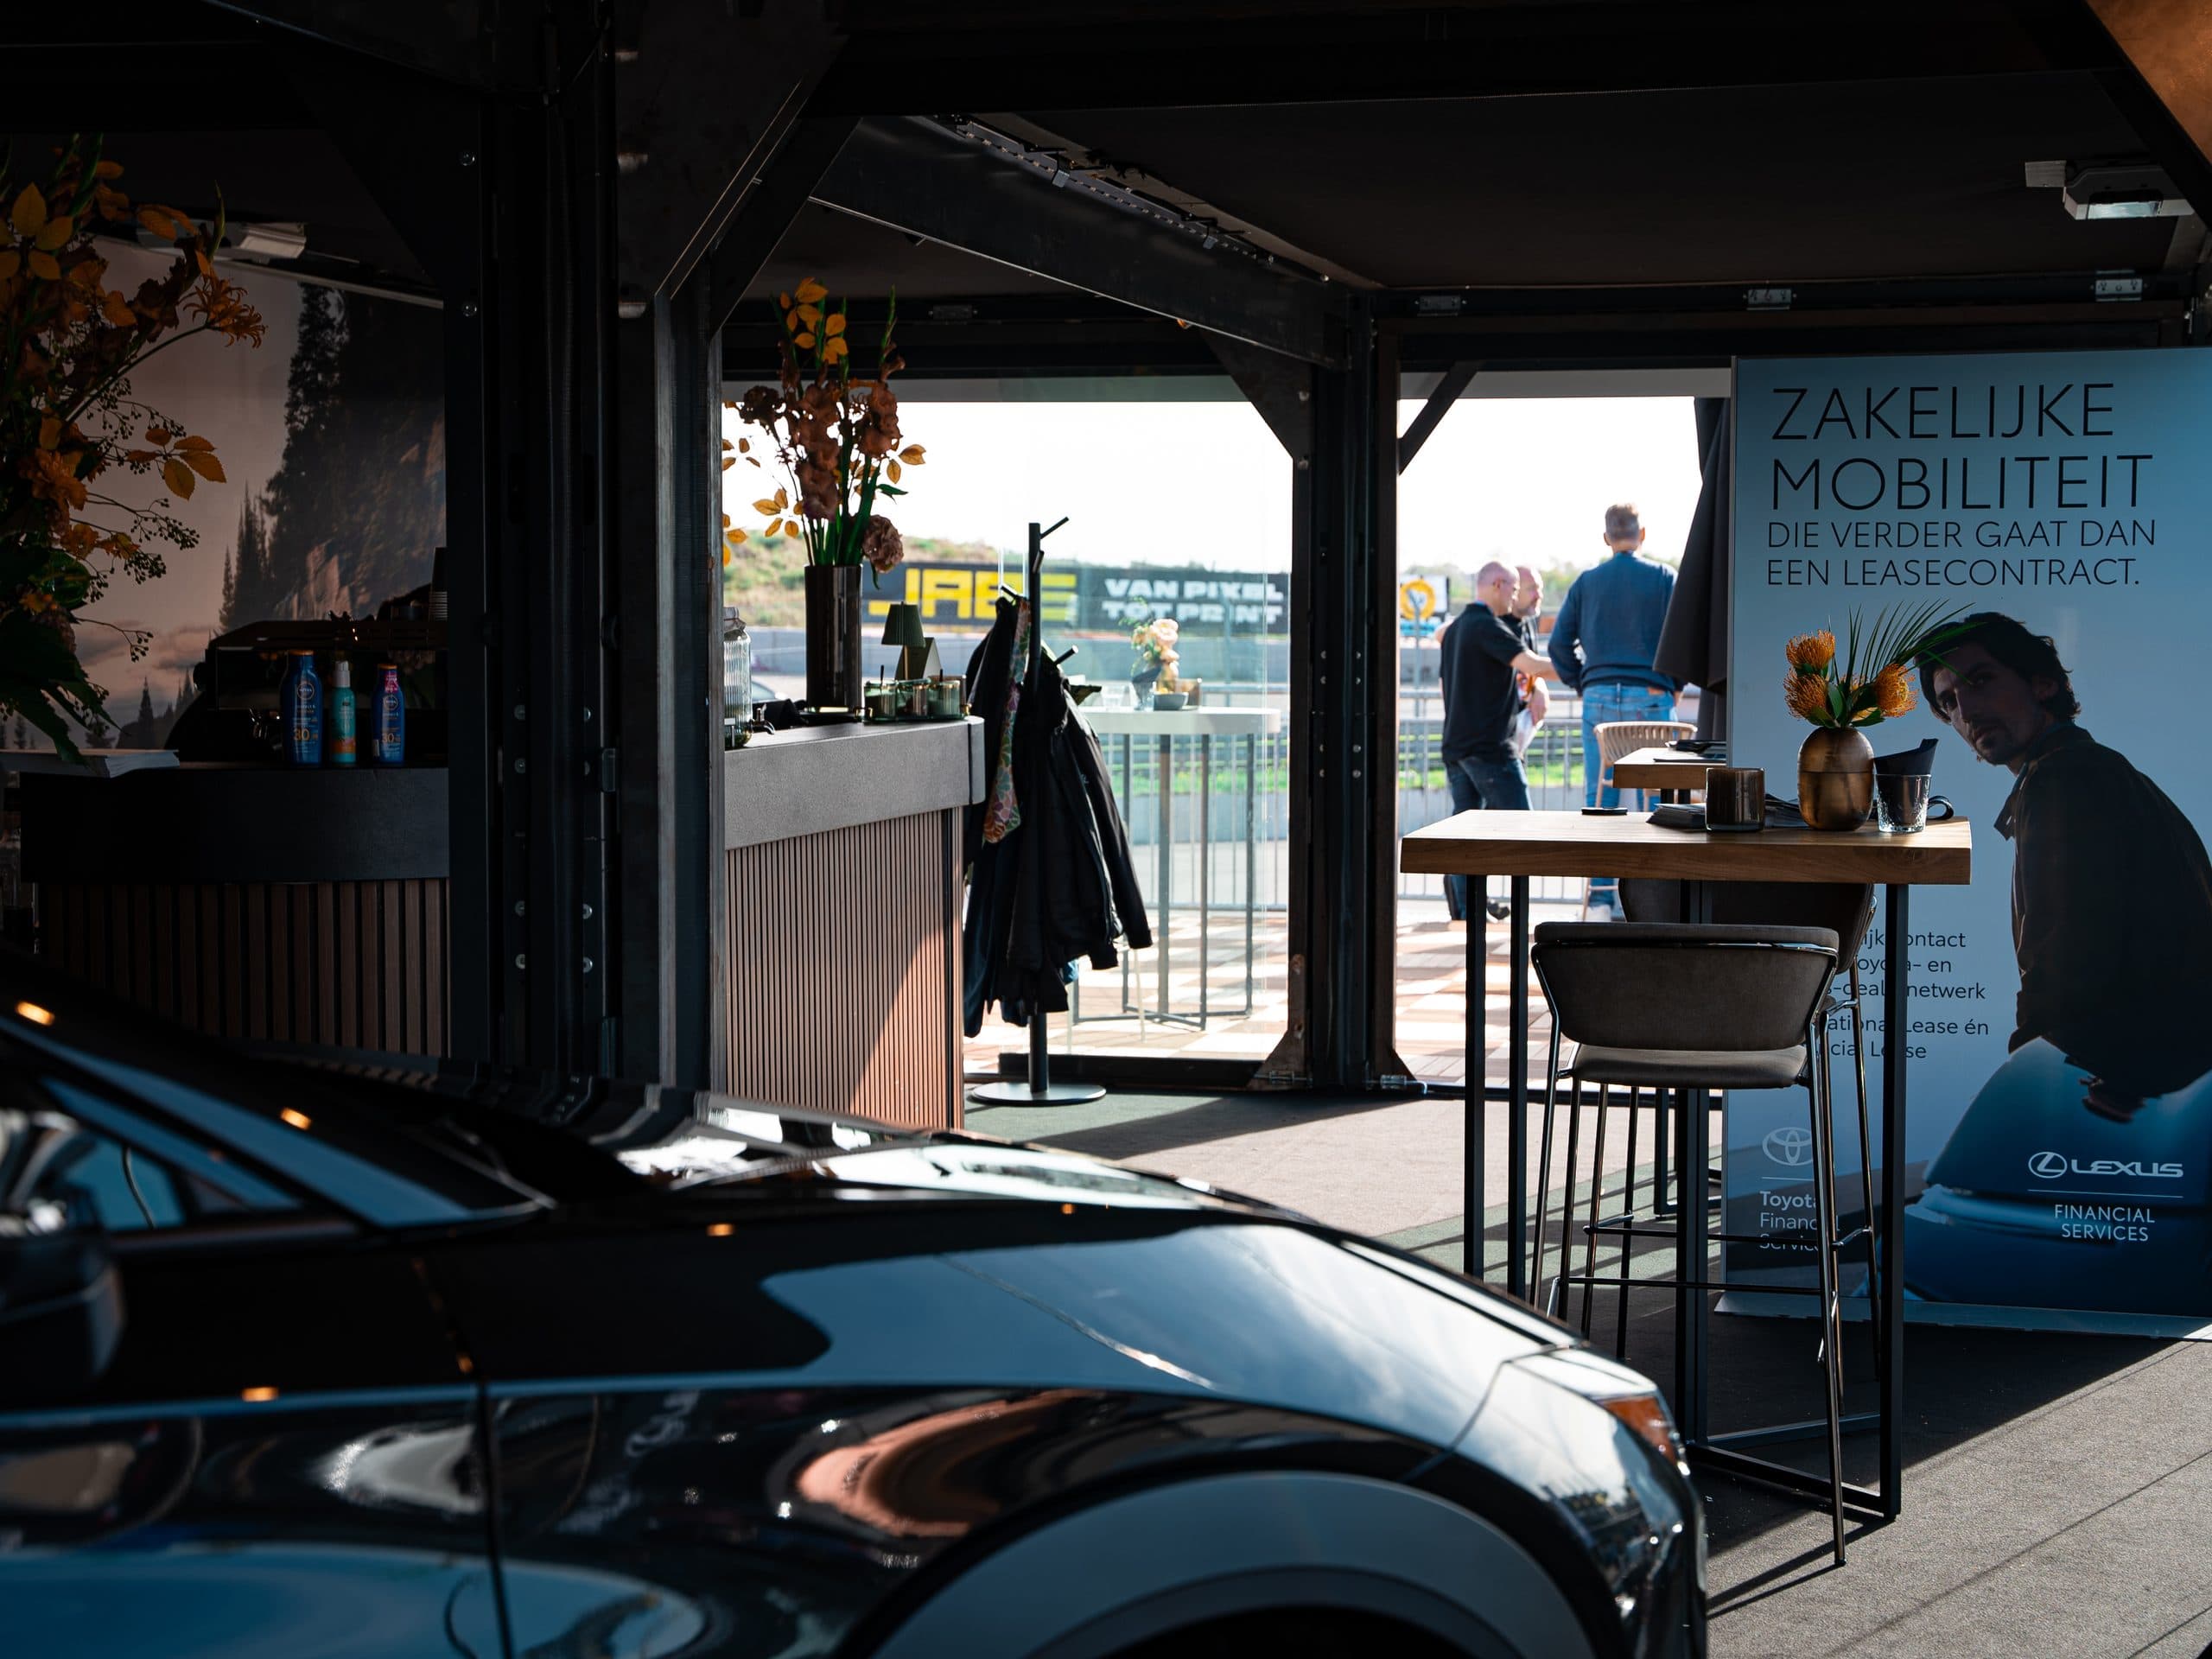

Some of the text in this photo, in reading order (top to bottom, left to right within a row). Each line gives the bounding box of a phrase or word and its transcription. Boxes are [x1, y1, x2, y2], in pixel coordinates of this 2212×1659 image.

[1771, 383, 2114, 440] ZAKELIJKE
[1772, 454, 2153, 511] MOBILITEIT
[1768, 519, 2156, 548] DIE VERDER GAAT DAN
[1768, 558, 2140, 586] EEN LEASECONTRACT.
[1104, 579, 1284, 601] VAN PIXEL
[1102, 601, 1173, 621] TOT
[1908, 931, 1967, 948] ntact
[1927, 959, 1952, 973] en
[1964, 1018, 1989, 1035] én
[1871, 1040, 1927, 1058] Lse
[2070, 1158, 2185, 1179] LEXUS
[1759, 1211, 1840, 1231] Financl
[2054, 1204, 2156, 1224] FINANCIAL
[2061, 1223, 2149, 1242] SERVICES
